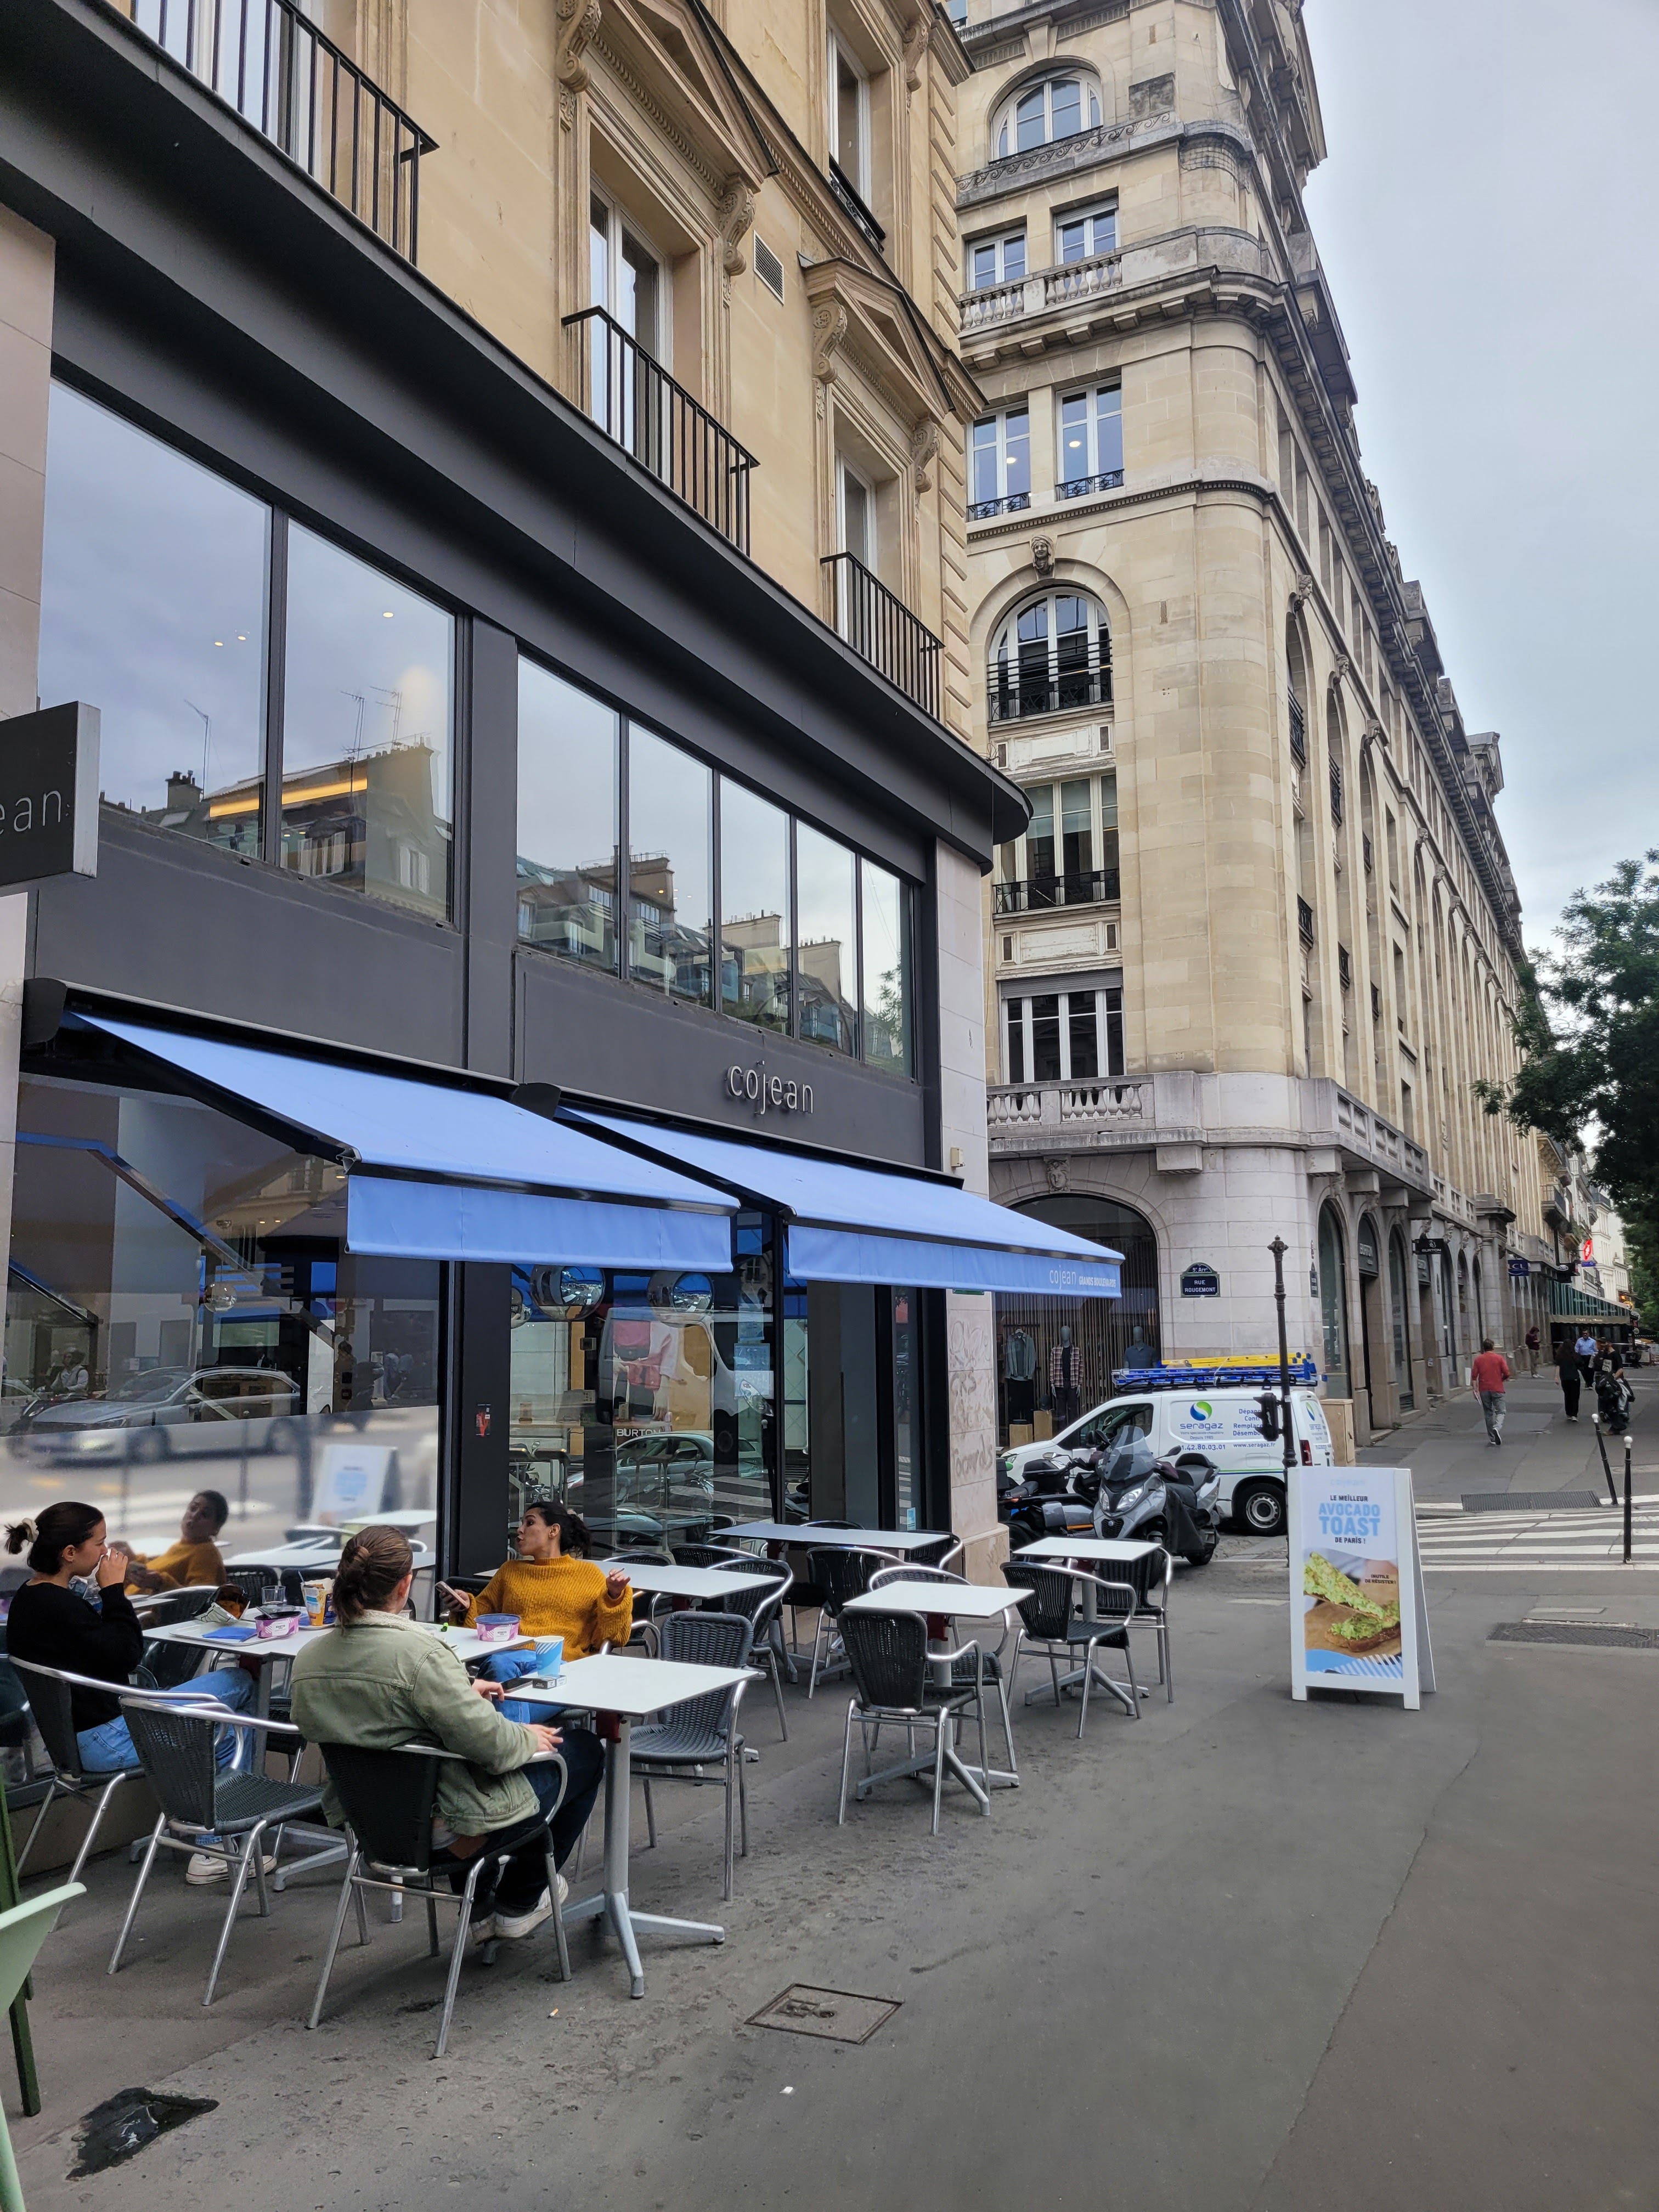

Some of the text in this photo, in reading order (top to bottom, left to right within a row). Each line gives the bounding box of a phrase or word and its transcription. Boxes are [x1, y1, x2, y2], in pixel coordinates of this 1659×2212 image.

[726, 1060, 814, 1115] cojean
[1049, 1265, 1076, 1289] cojean
[1180, 1423, 1224, 1431] seragaz
[1318, 1503, 1380, 1517] AVOCADO
[1318, 1516, 1380, 1536] TOAST
